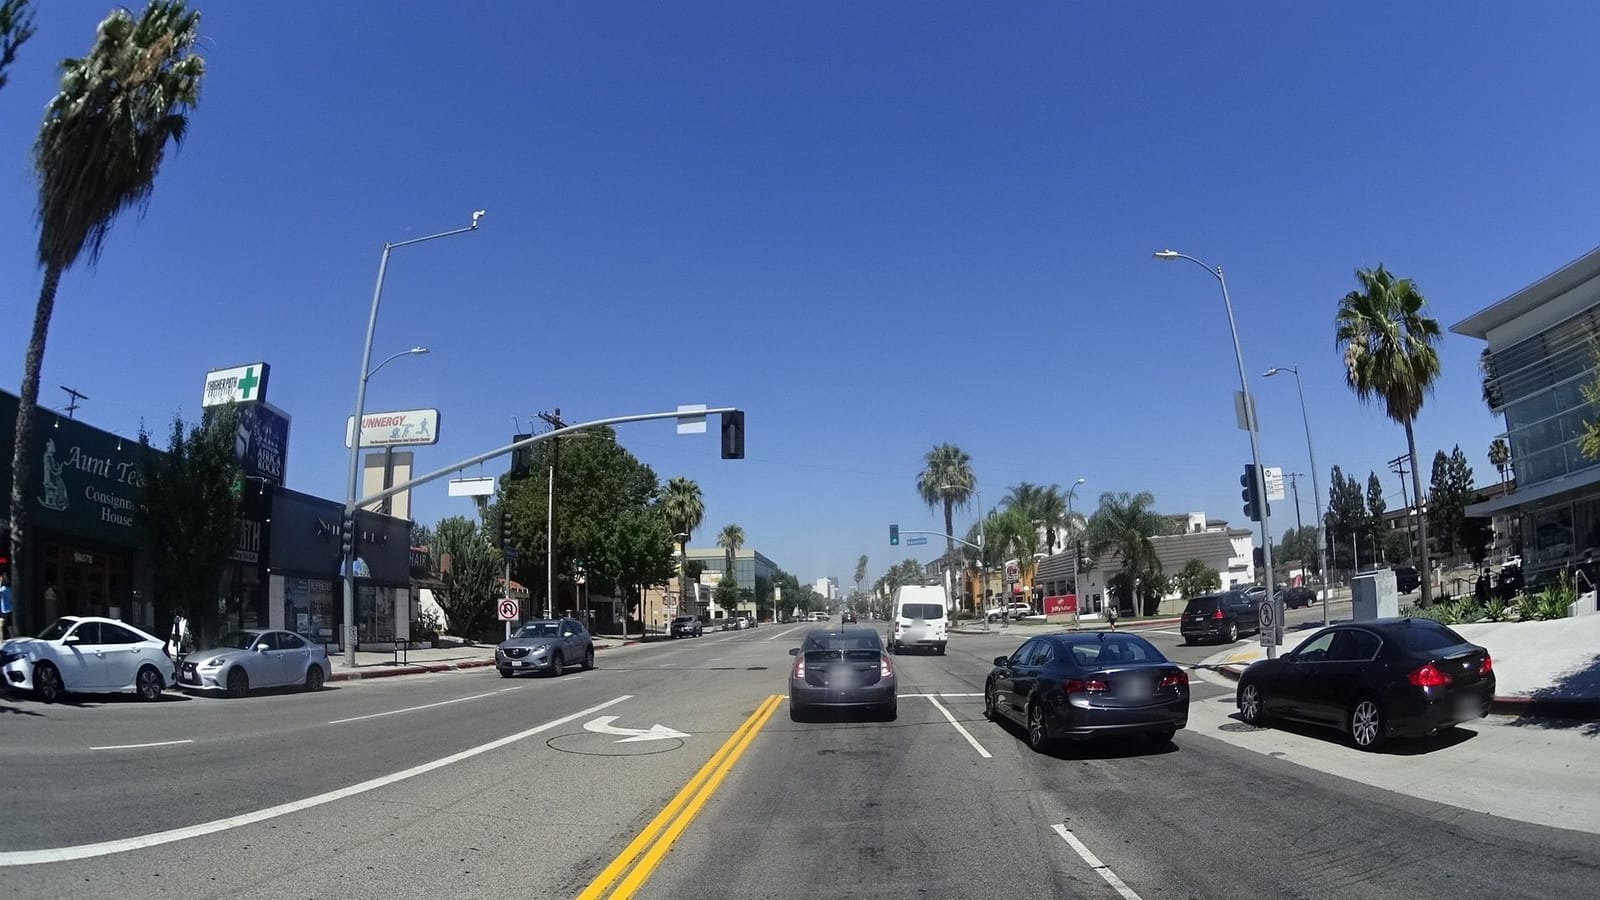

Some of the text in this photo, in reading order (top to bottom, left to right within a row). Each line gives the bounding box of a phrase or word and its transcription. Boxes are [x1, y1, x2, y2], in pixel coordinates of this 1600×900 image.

[361, 416, 406, 429] UNNERGY
[64, 446, 112, 478] Aunt
[101, 506, 133, 527] House
[408, 552, 427, 567] HAIR
